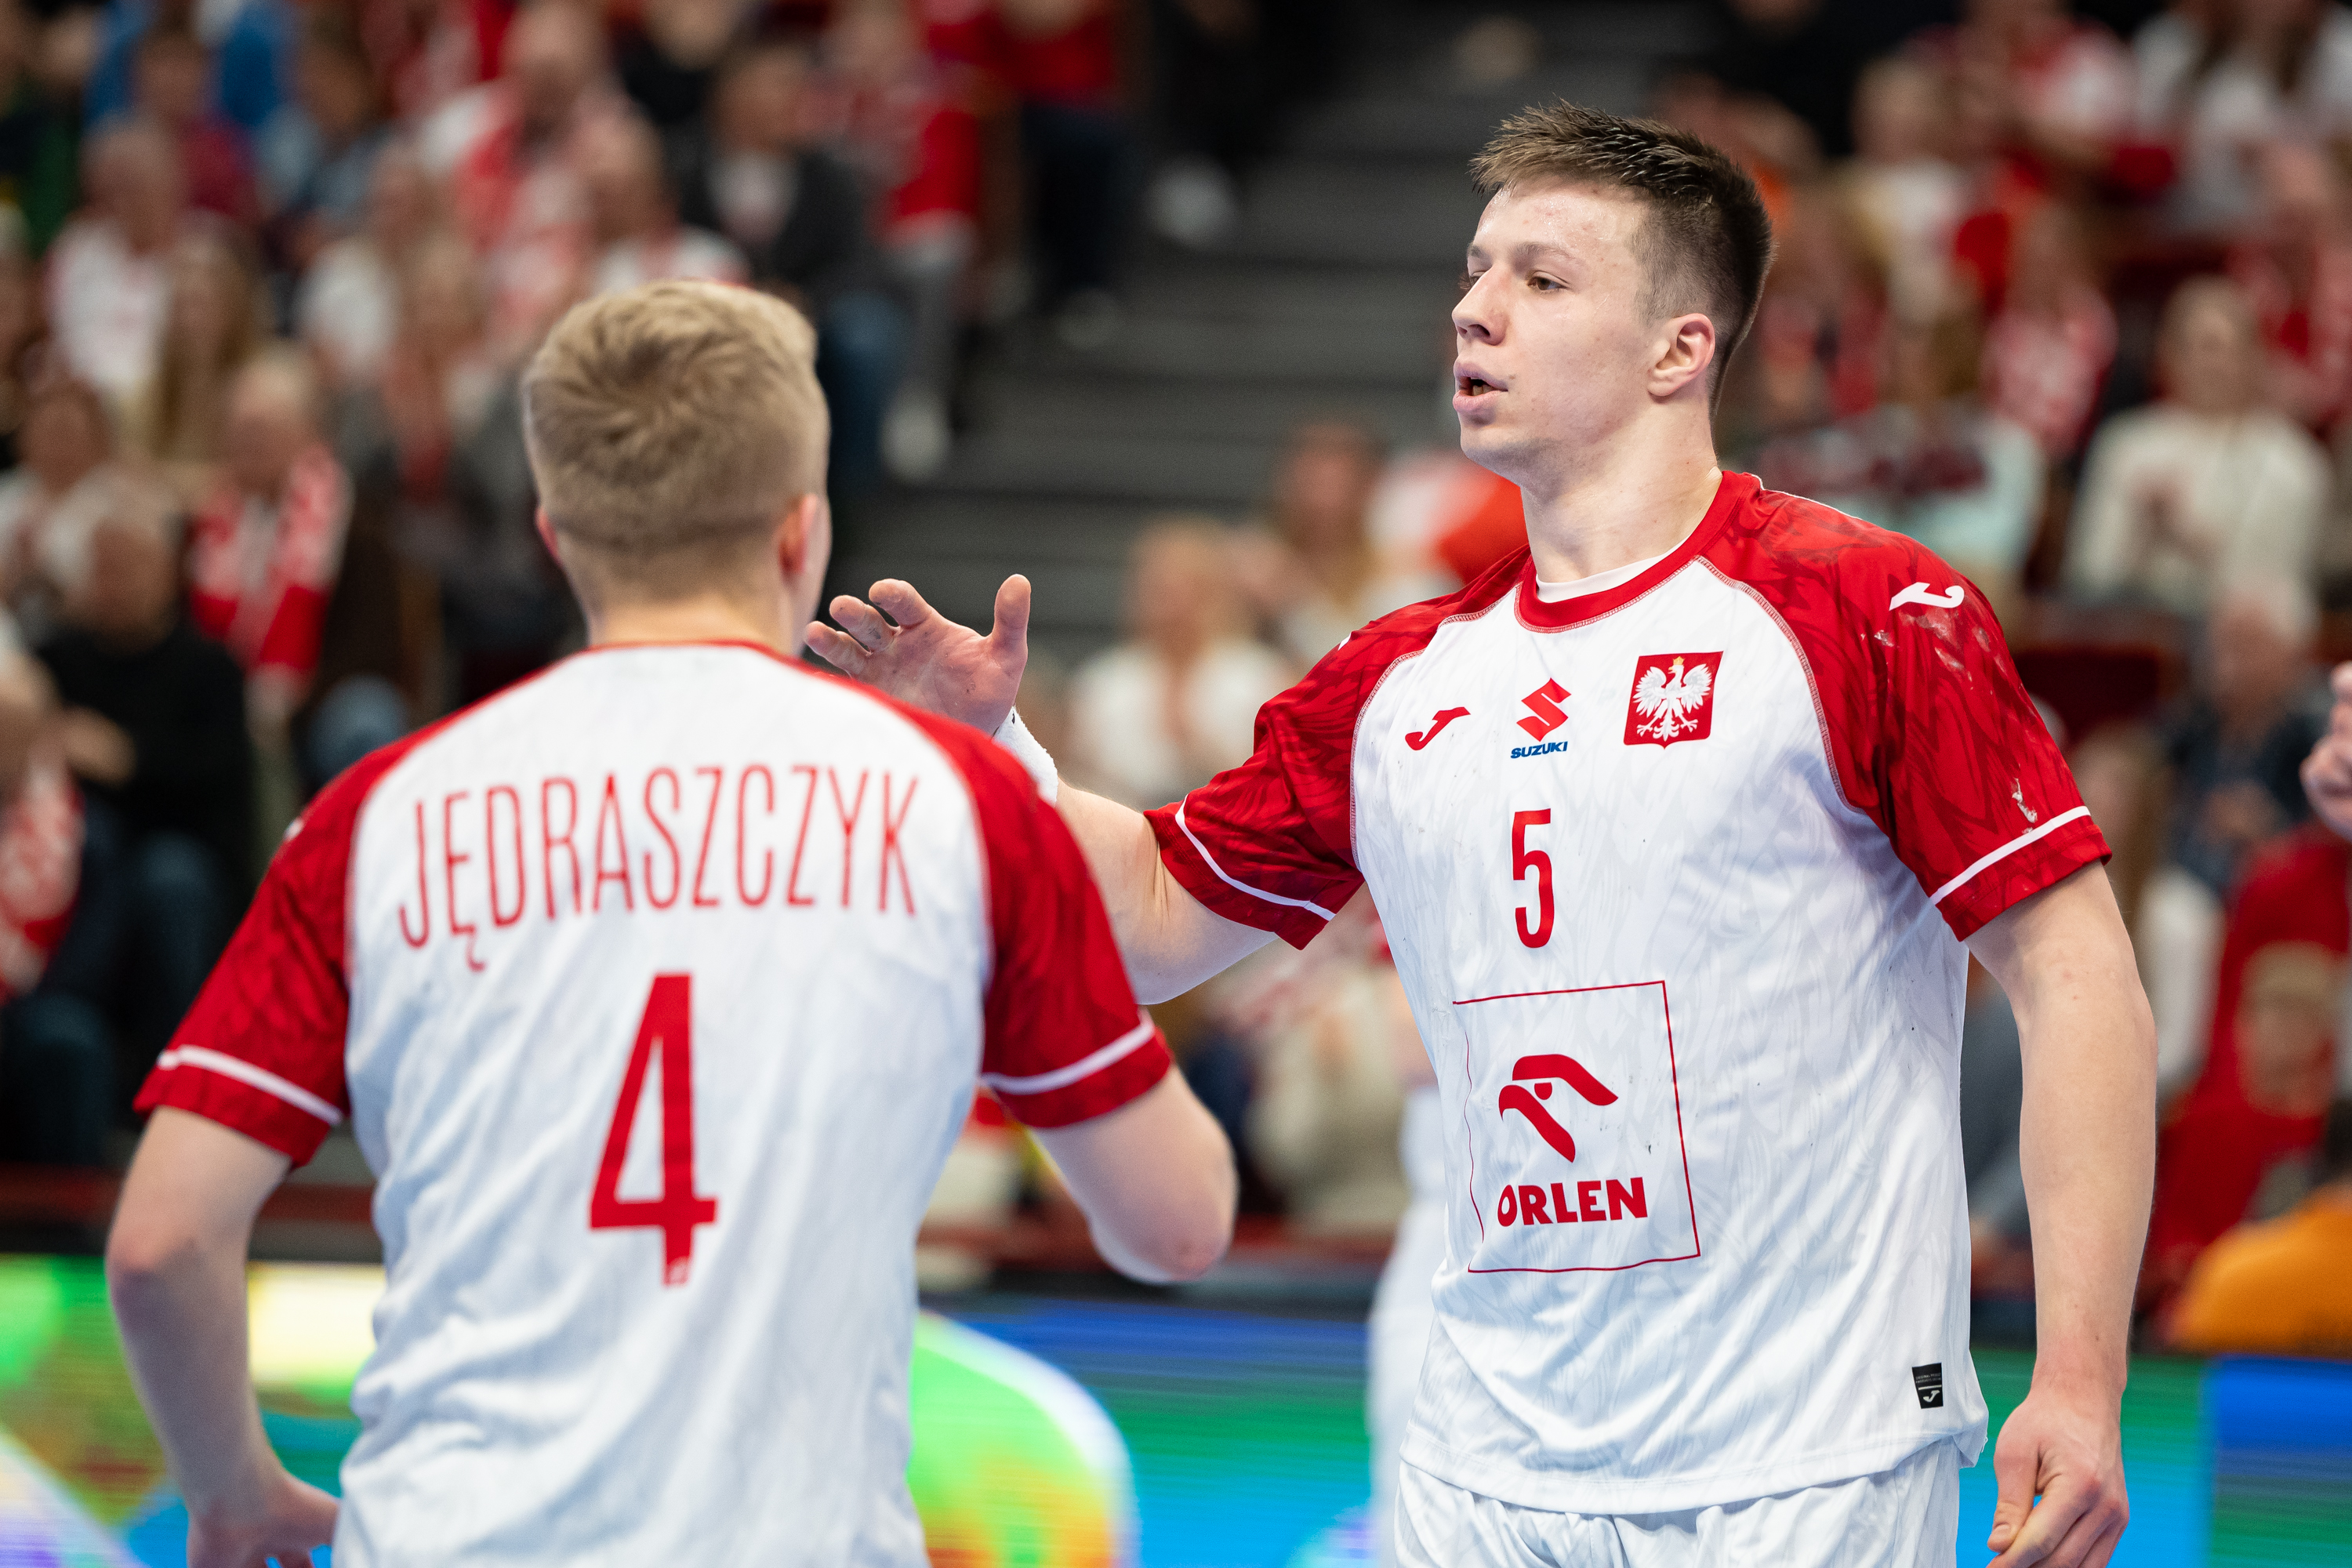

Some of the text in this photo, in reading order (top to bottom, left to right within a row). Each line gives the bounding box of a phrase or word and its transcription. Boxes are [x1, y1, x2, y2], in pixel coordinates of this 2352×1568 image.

[1510, 740, 1568, 759] SUZUKI
[398, 764, 919, 972] JĘDRASZCZYK
[1511, 808, 1555, 949] 5
[588, 971, 718, 1287] 4
[1497, 1176, 1648, 1227] ORLEN
